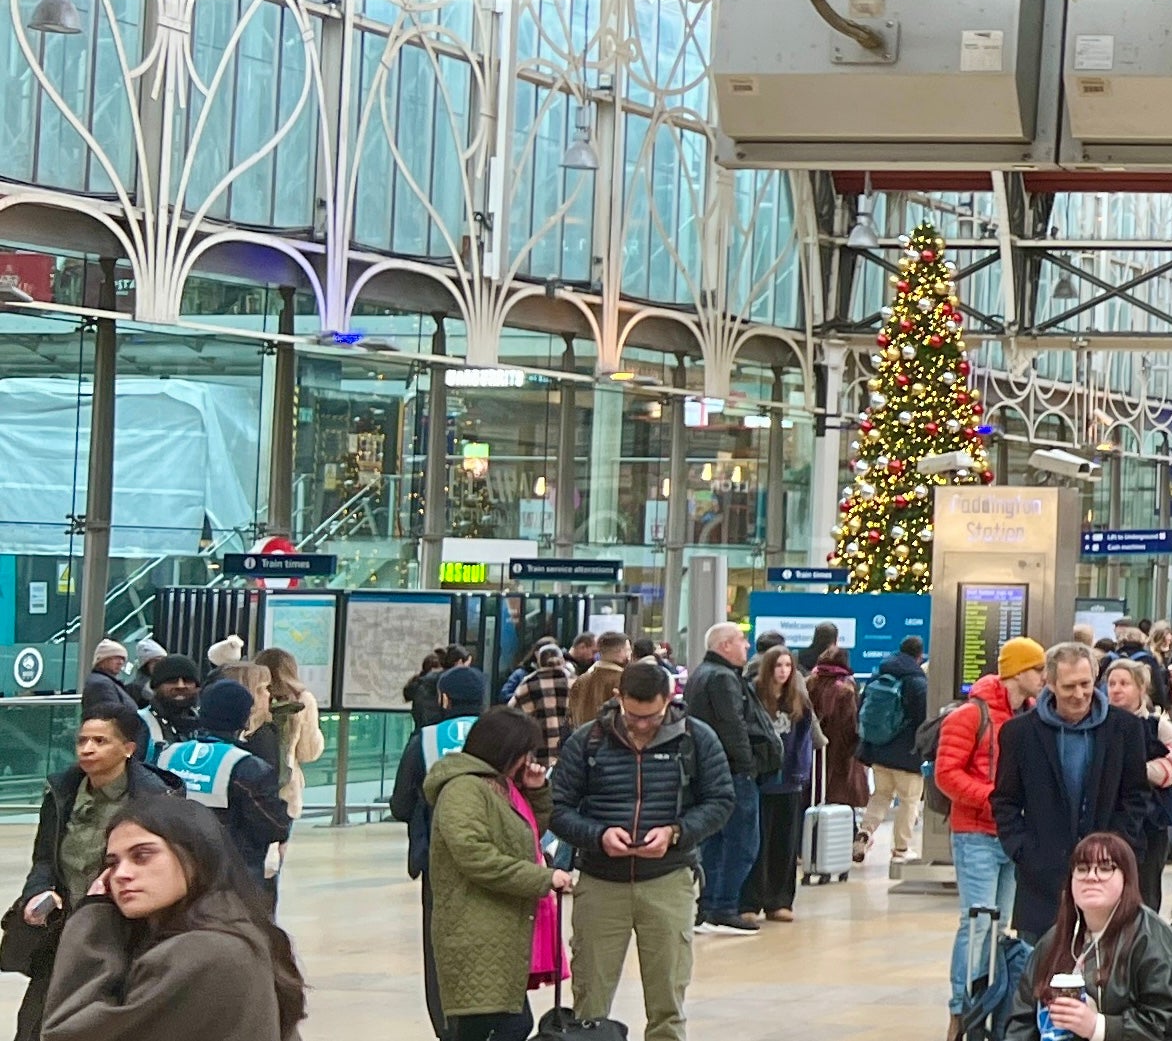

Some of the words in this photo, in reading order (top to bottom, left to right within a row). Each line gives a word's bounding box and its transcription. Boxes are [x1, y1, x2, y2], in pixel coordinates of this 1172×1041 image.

[967, 522, 1024, 542] Station
[261, 558, 282, 568] Train
[285, 559, 310, 568] times
[795, 570, 812, 578] Train
